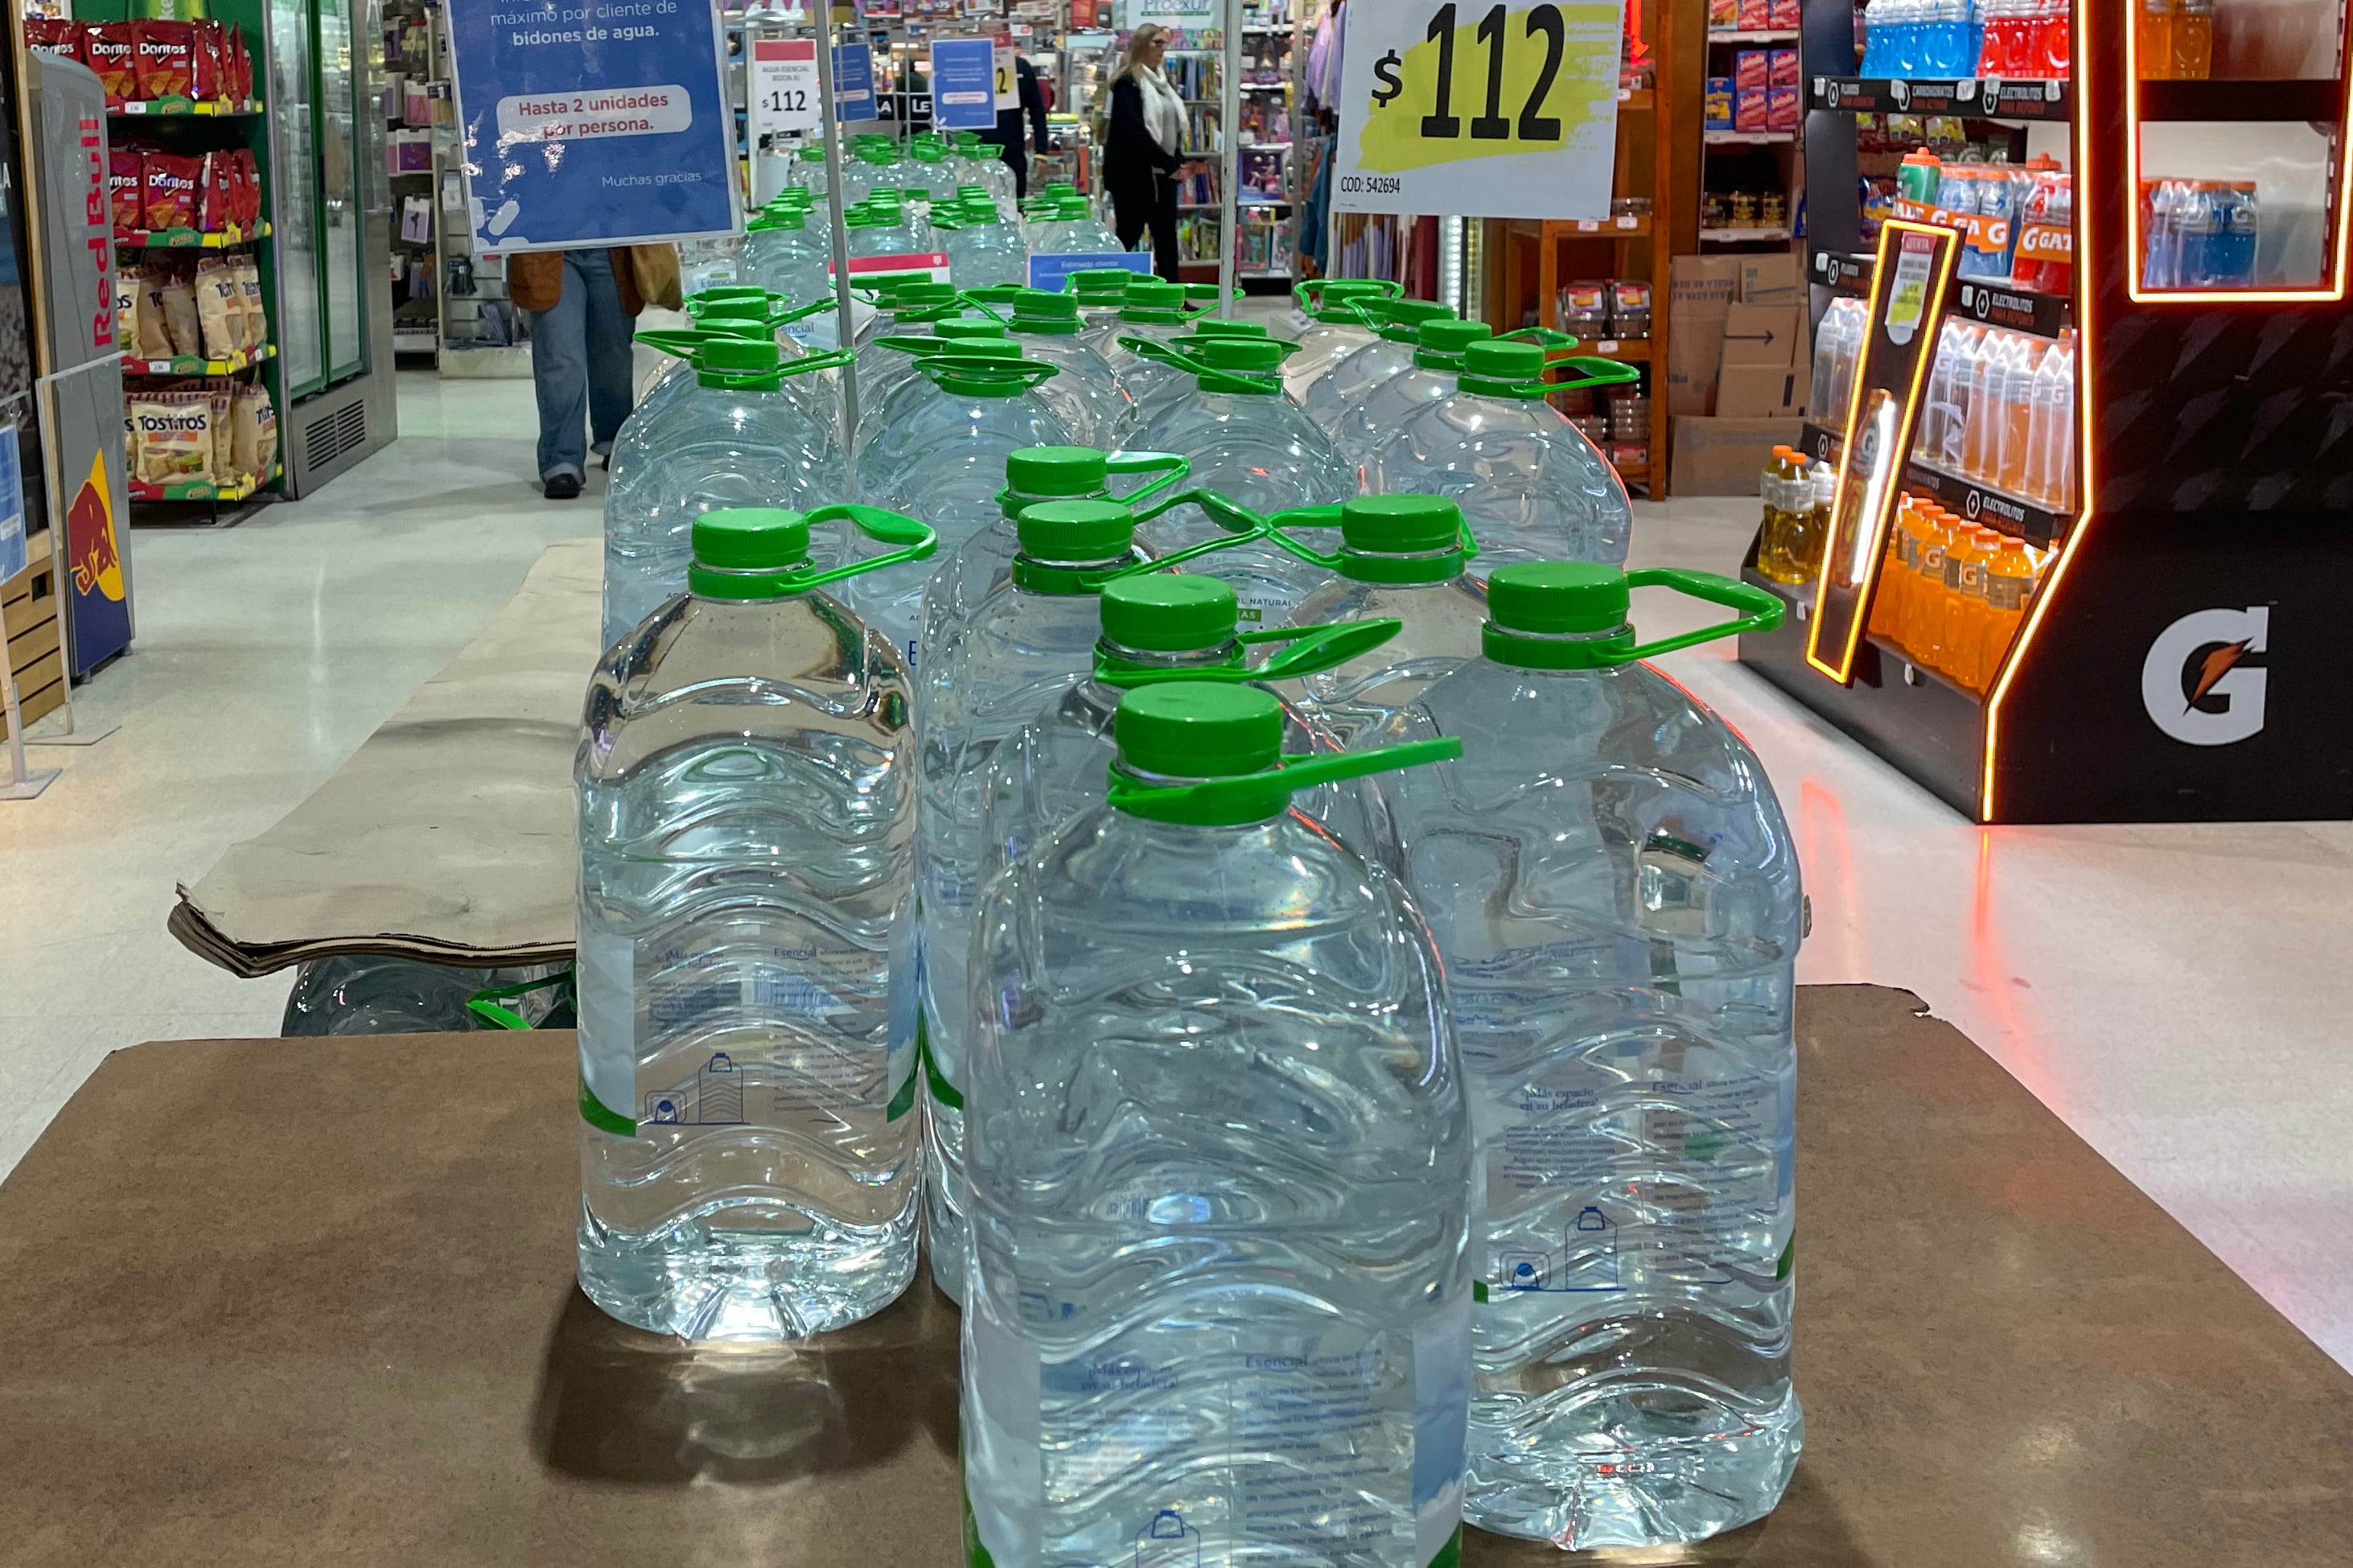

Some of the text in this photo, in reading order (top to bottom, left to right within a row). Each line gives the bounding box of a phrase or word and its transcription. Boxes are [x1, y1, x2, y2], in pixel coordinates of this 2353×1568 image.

[491, 0, 677, 26] máximo por cliente de
[512, 25, 660, 46] bidones de agua.
[30, 43, 74, 55] Doritos
[92, 43, 132, 56] Dorito
[139, 43, 187, 55] Doritos
[1372, 2, 1565, 141] $ 112
[519, 93, 668, 117] Hasta 2 unidades
[762, 90, 807, 111] $ 112
[543, 118, 654, 139] por persona.
[109, 175, 138, 187] ritos
[148, 174, 194, 190] Doritos
[602, 171, 702, 187] Muchas gracias
[1341, 176, 1401, 194] COD: 542694
[79, 119, 113, 347] Red Bull
[1988, 221, 2006, 245] G
[2022, 227, 2040, 251] G
[780, 323, 814, 334] encial
[1983, 496, 2026, 522] ELECTROLITOS
[1925, 549, 1942, 568] G
[1962, 566, 1977, 586] G
[2141, 606, 2269, 747] G
[775, 947, 817, 958] Esencial
[1556, 1088, 1594, 1101] espacio
